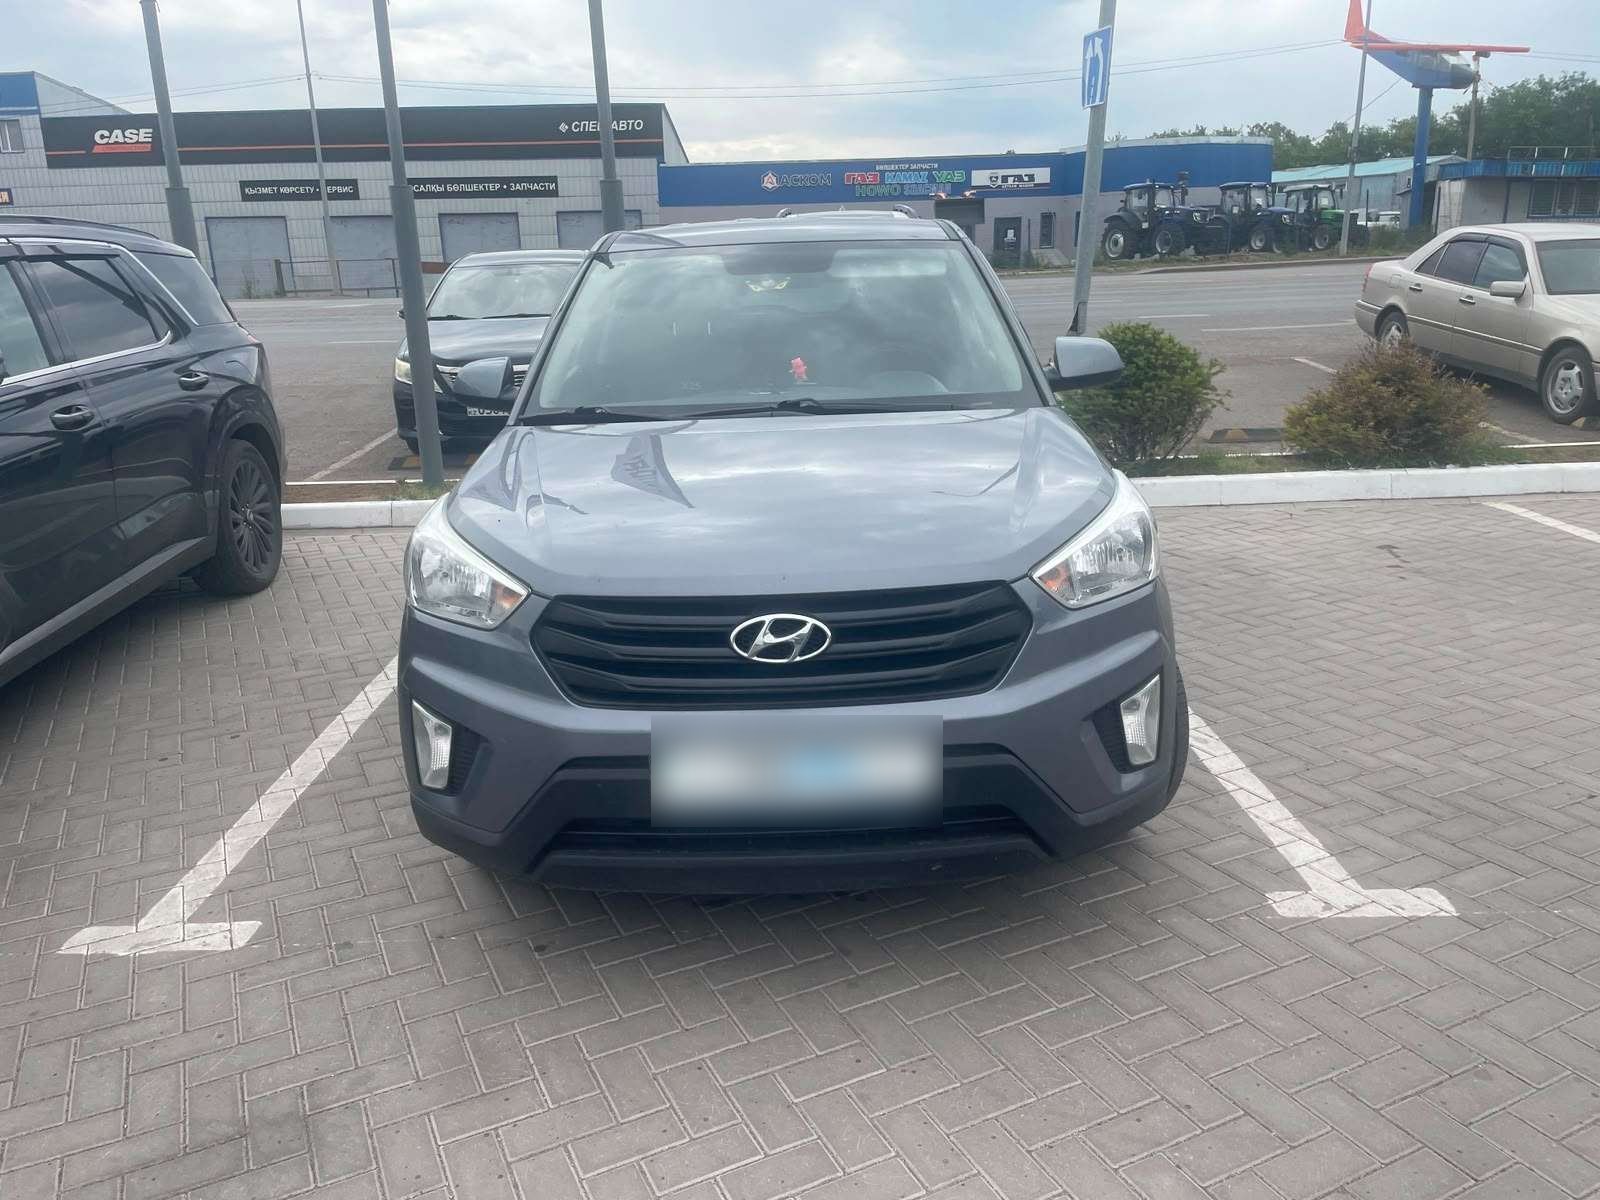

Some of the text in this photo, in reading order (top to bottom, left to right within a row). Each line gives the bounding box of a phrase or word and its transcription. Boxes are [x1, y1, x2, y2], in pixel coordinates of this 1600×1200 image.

[571, 119, 644, 133] СПЕАВТО
[94, 128, 153, 144] CASE
[779, 173, 832, 187] АСКОМ
[844, 172, 880, 184] ГАЗ
[932, 170, 966, 183] УАЗ
[1000, 173, 1036, 184] ГАЗ
[324, 185, 354, 194] ЕРВИС
[407, 182, 557, 194] САЛҚЫ БӨЛШЕКТЕР ЗАПЧАСТИ
